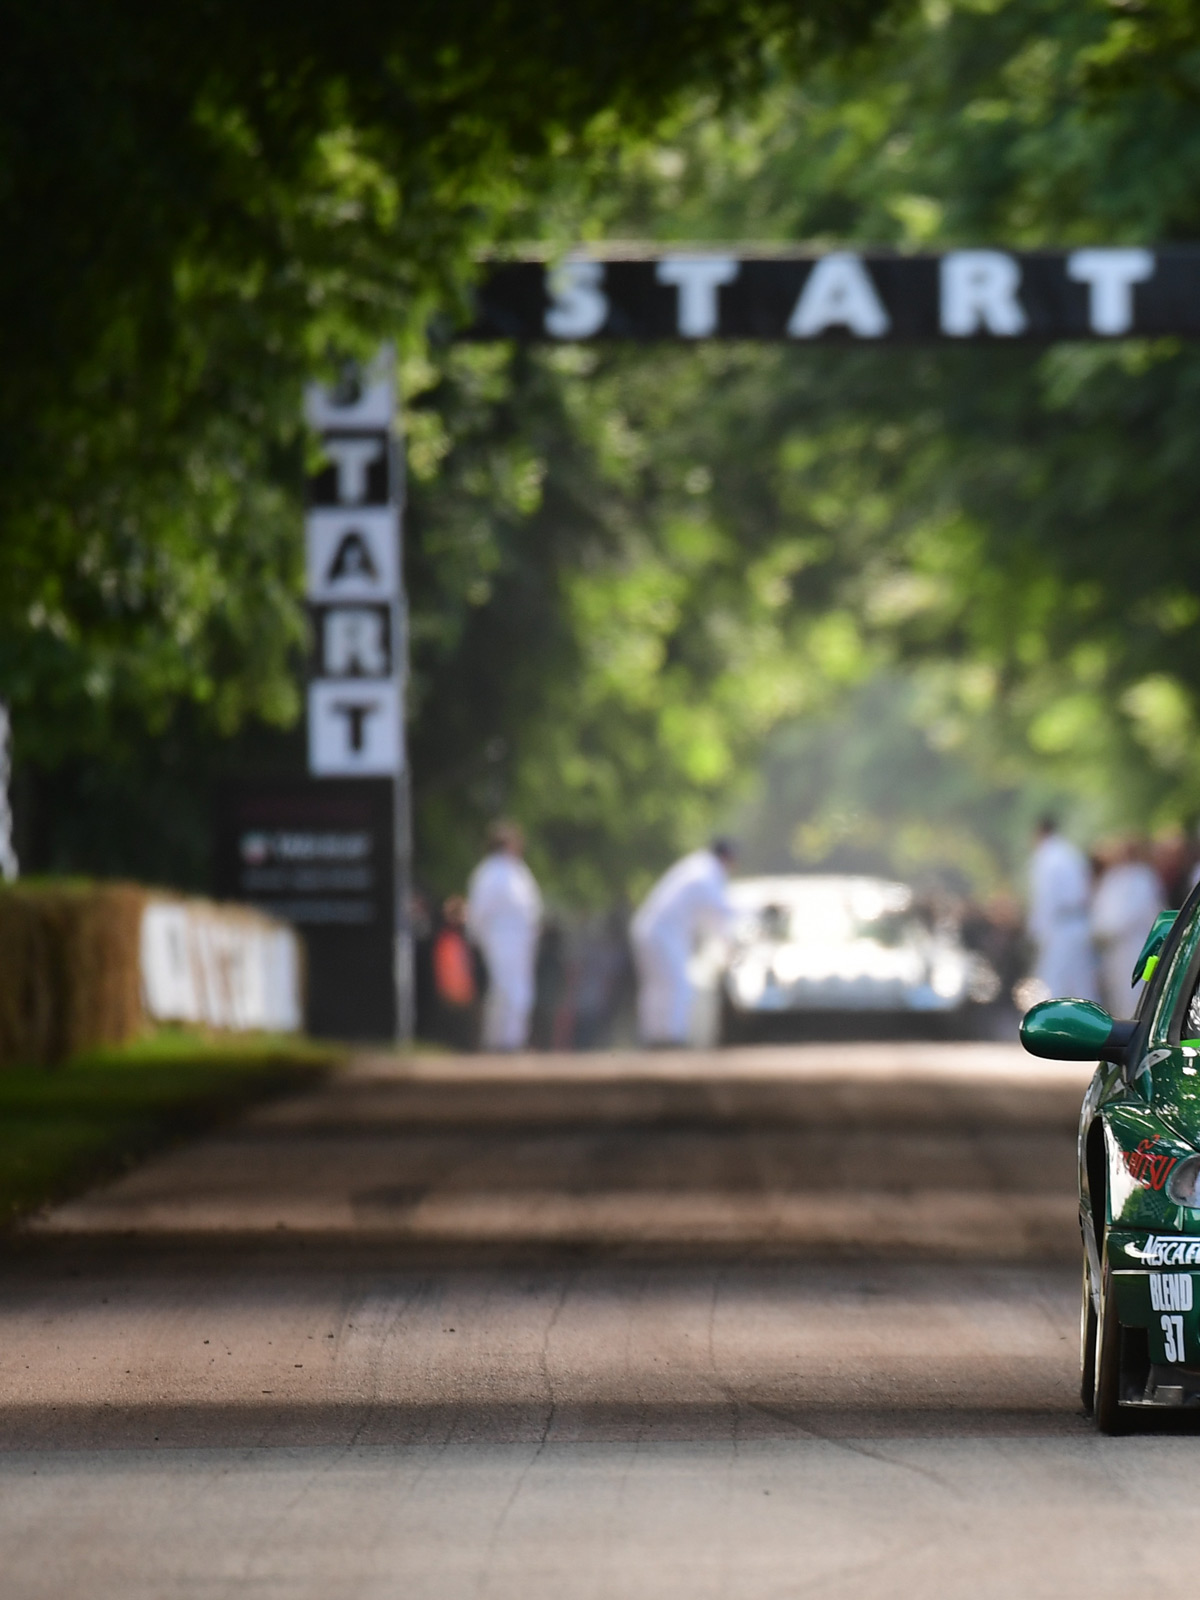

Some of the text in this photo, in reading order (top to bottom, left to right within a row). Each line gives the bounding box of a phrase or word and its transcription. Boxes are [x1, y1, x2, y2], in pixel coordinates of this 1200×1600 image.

[545, 251, 1155, 338] START
[1149, 1273, 1193, 1311] BLEND
[1161, 1314, 1185, 1362] 37
